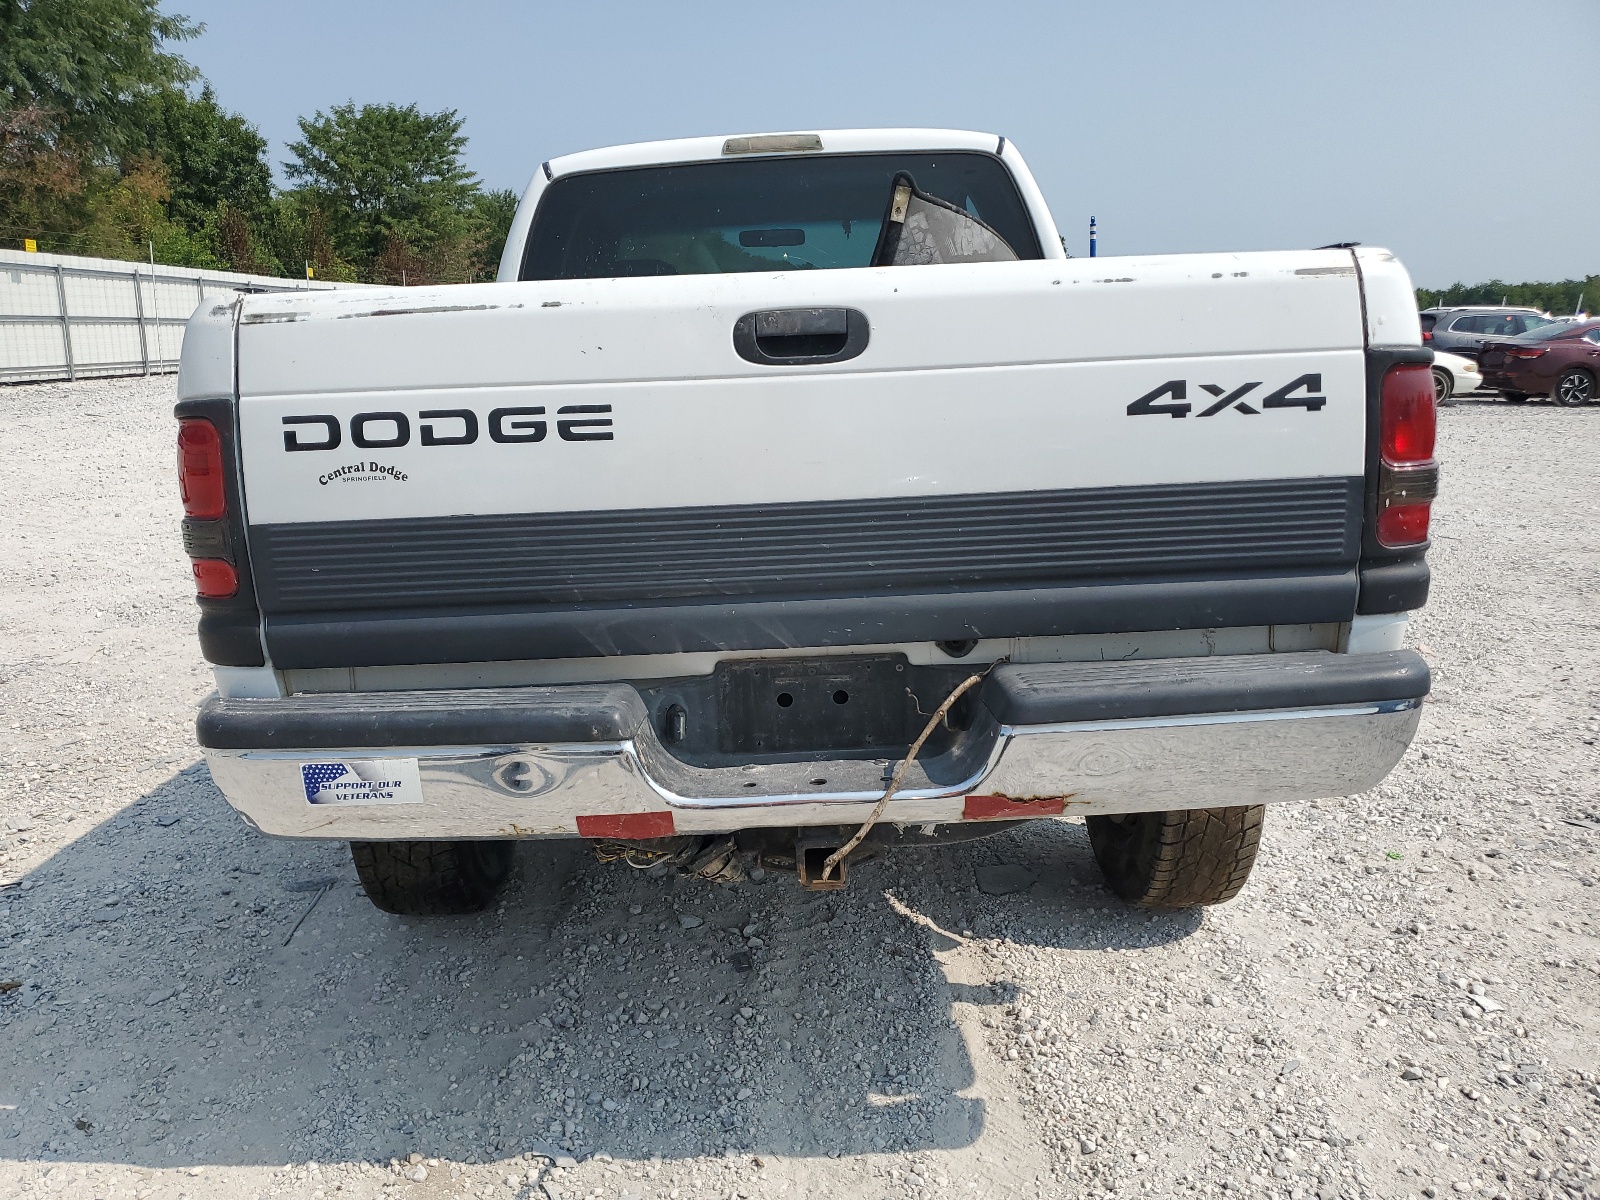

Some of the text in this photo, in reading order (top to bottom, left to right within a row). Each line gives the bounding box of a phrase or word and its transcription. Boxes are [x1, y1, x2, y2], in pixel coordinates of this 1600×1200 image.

[281, 404, 614, 452] DODGE
[318, 461, 409, 486] Central Dodge
[342, 475, 387, 483] SPRINGFIELD
[320, 780, 402, 791] SUPPORT OUR
[335, 791, 394, 801] VETERANS
